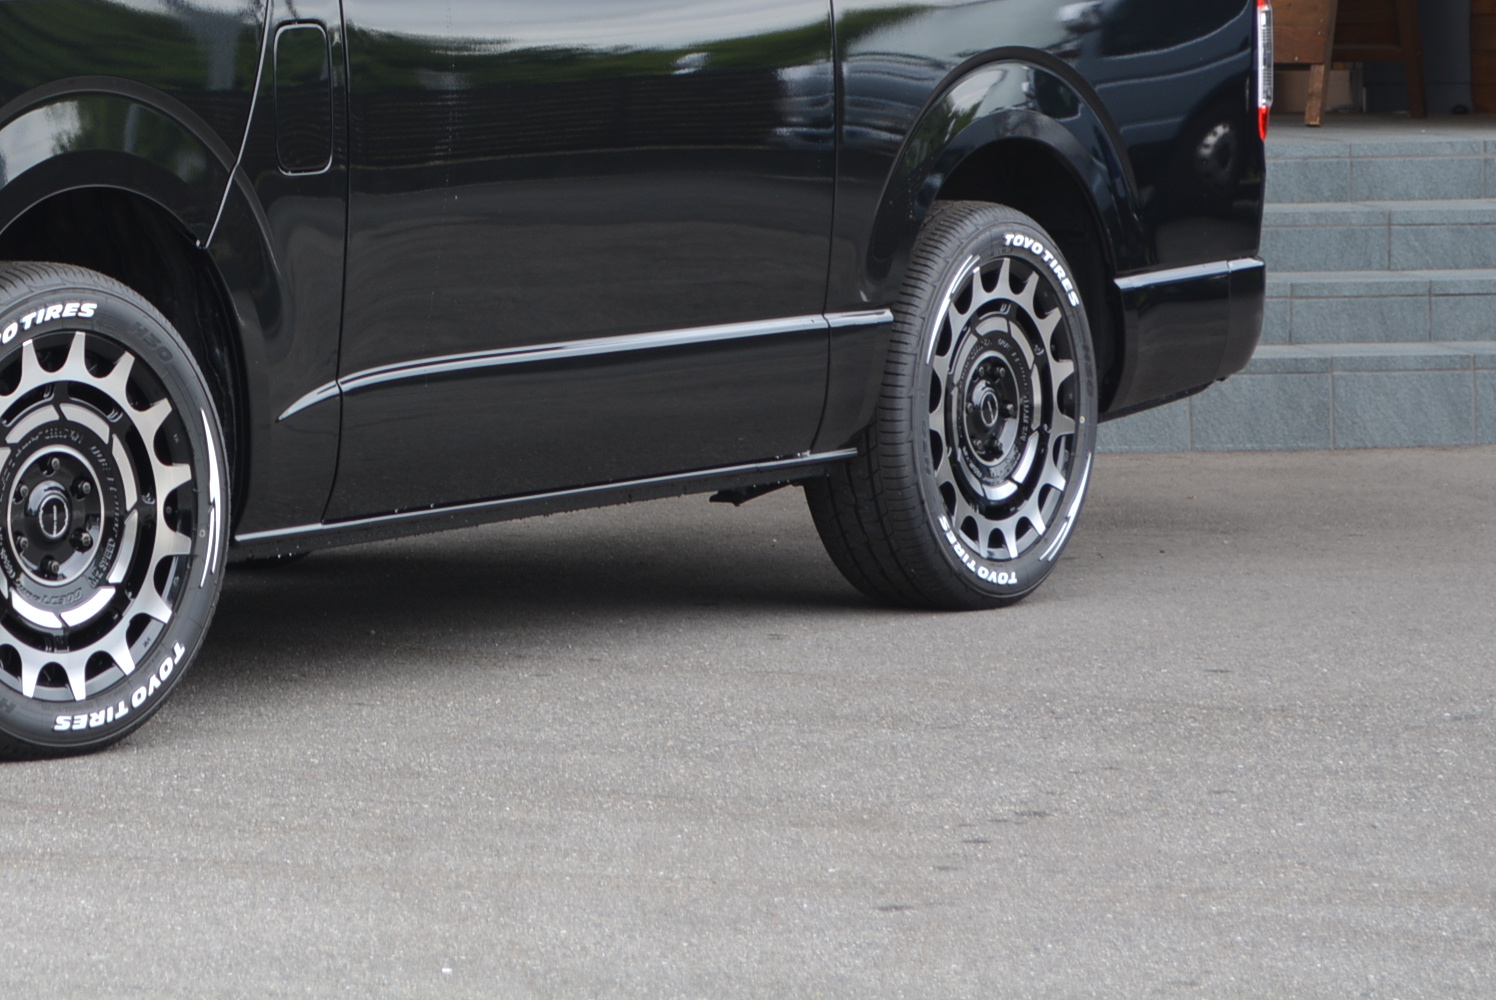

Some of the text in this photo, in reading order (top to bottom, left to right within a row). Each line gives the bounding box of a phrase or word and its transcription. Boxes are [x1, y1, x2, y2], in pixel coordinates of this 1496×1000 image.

[1005, 234, 1080, 307] TOYO TIRES
[20, 302, 98, 331] TIRES
[938, 515, 1018, 585] TOYO TIRES
[54, 642, 185, 731] TOYO TIRES
